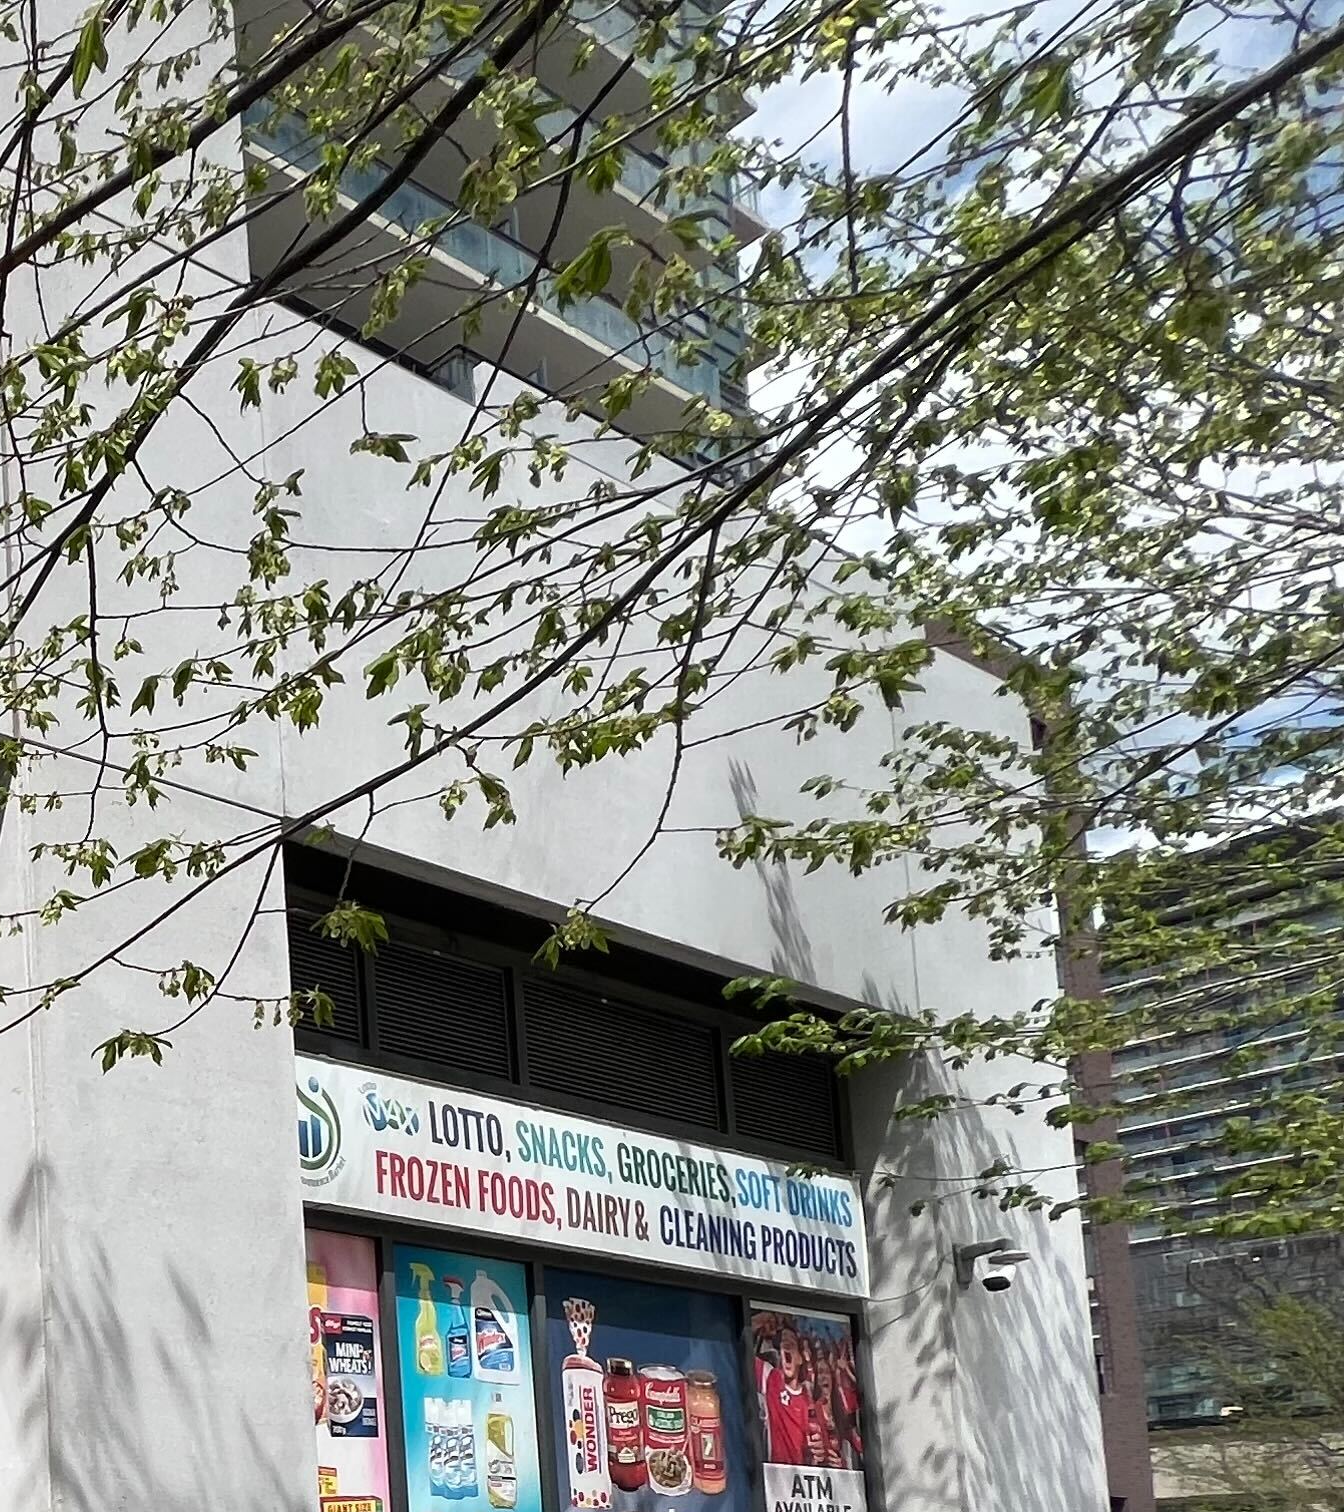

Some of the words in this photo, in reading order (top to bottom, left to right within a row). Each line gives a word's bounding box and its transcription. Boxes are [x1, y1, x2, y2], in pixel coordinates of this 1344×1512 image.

[429, 1101, 511, 1162] LOTTO,
[515, 1120, 613, 1184] SNACKS,
[617, 1142, 737, 1208] GROCERIES,
[736, 1168, 781, 1213] SOFT
[786, 1178, 854, 1228] DRINKS
[376, 1150, 471, 1210] FROZEN
[477, 1169, 562, 1231] FOODS,
[567, 1186, 631, 1239] DAIRY
[635, 1200, 650, 1241] &
[660, 1205, 757, 1260] CLEANING
[761, 1225, 858, 1279] PRODUCTS
[582, 1387, 598, 1473] WONDER
[609, 1405, 639, 1425] Prego
[355, 1502, 372, 1512] SIZE
[791, 1473, 833, 1500] ATM
